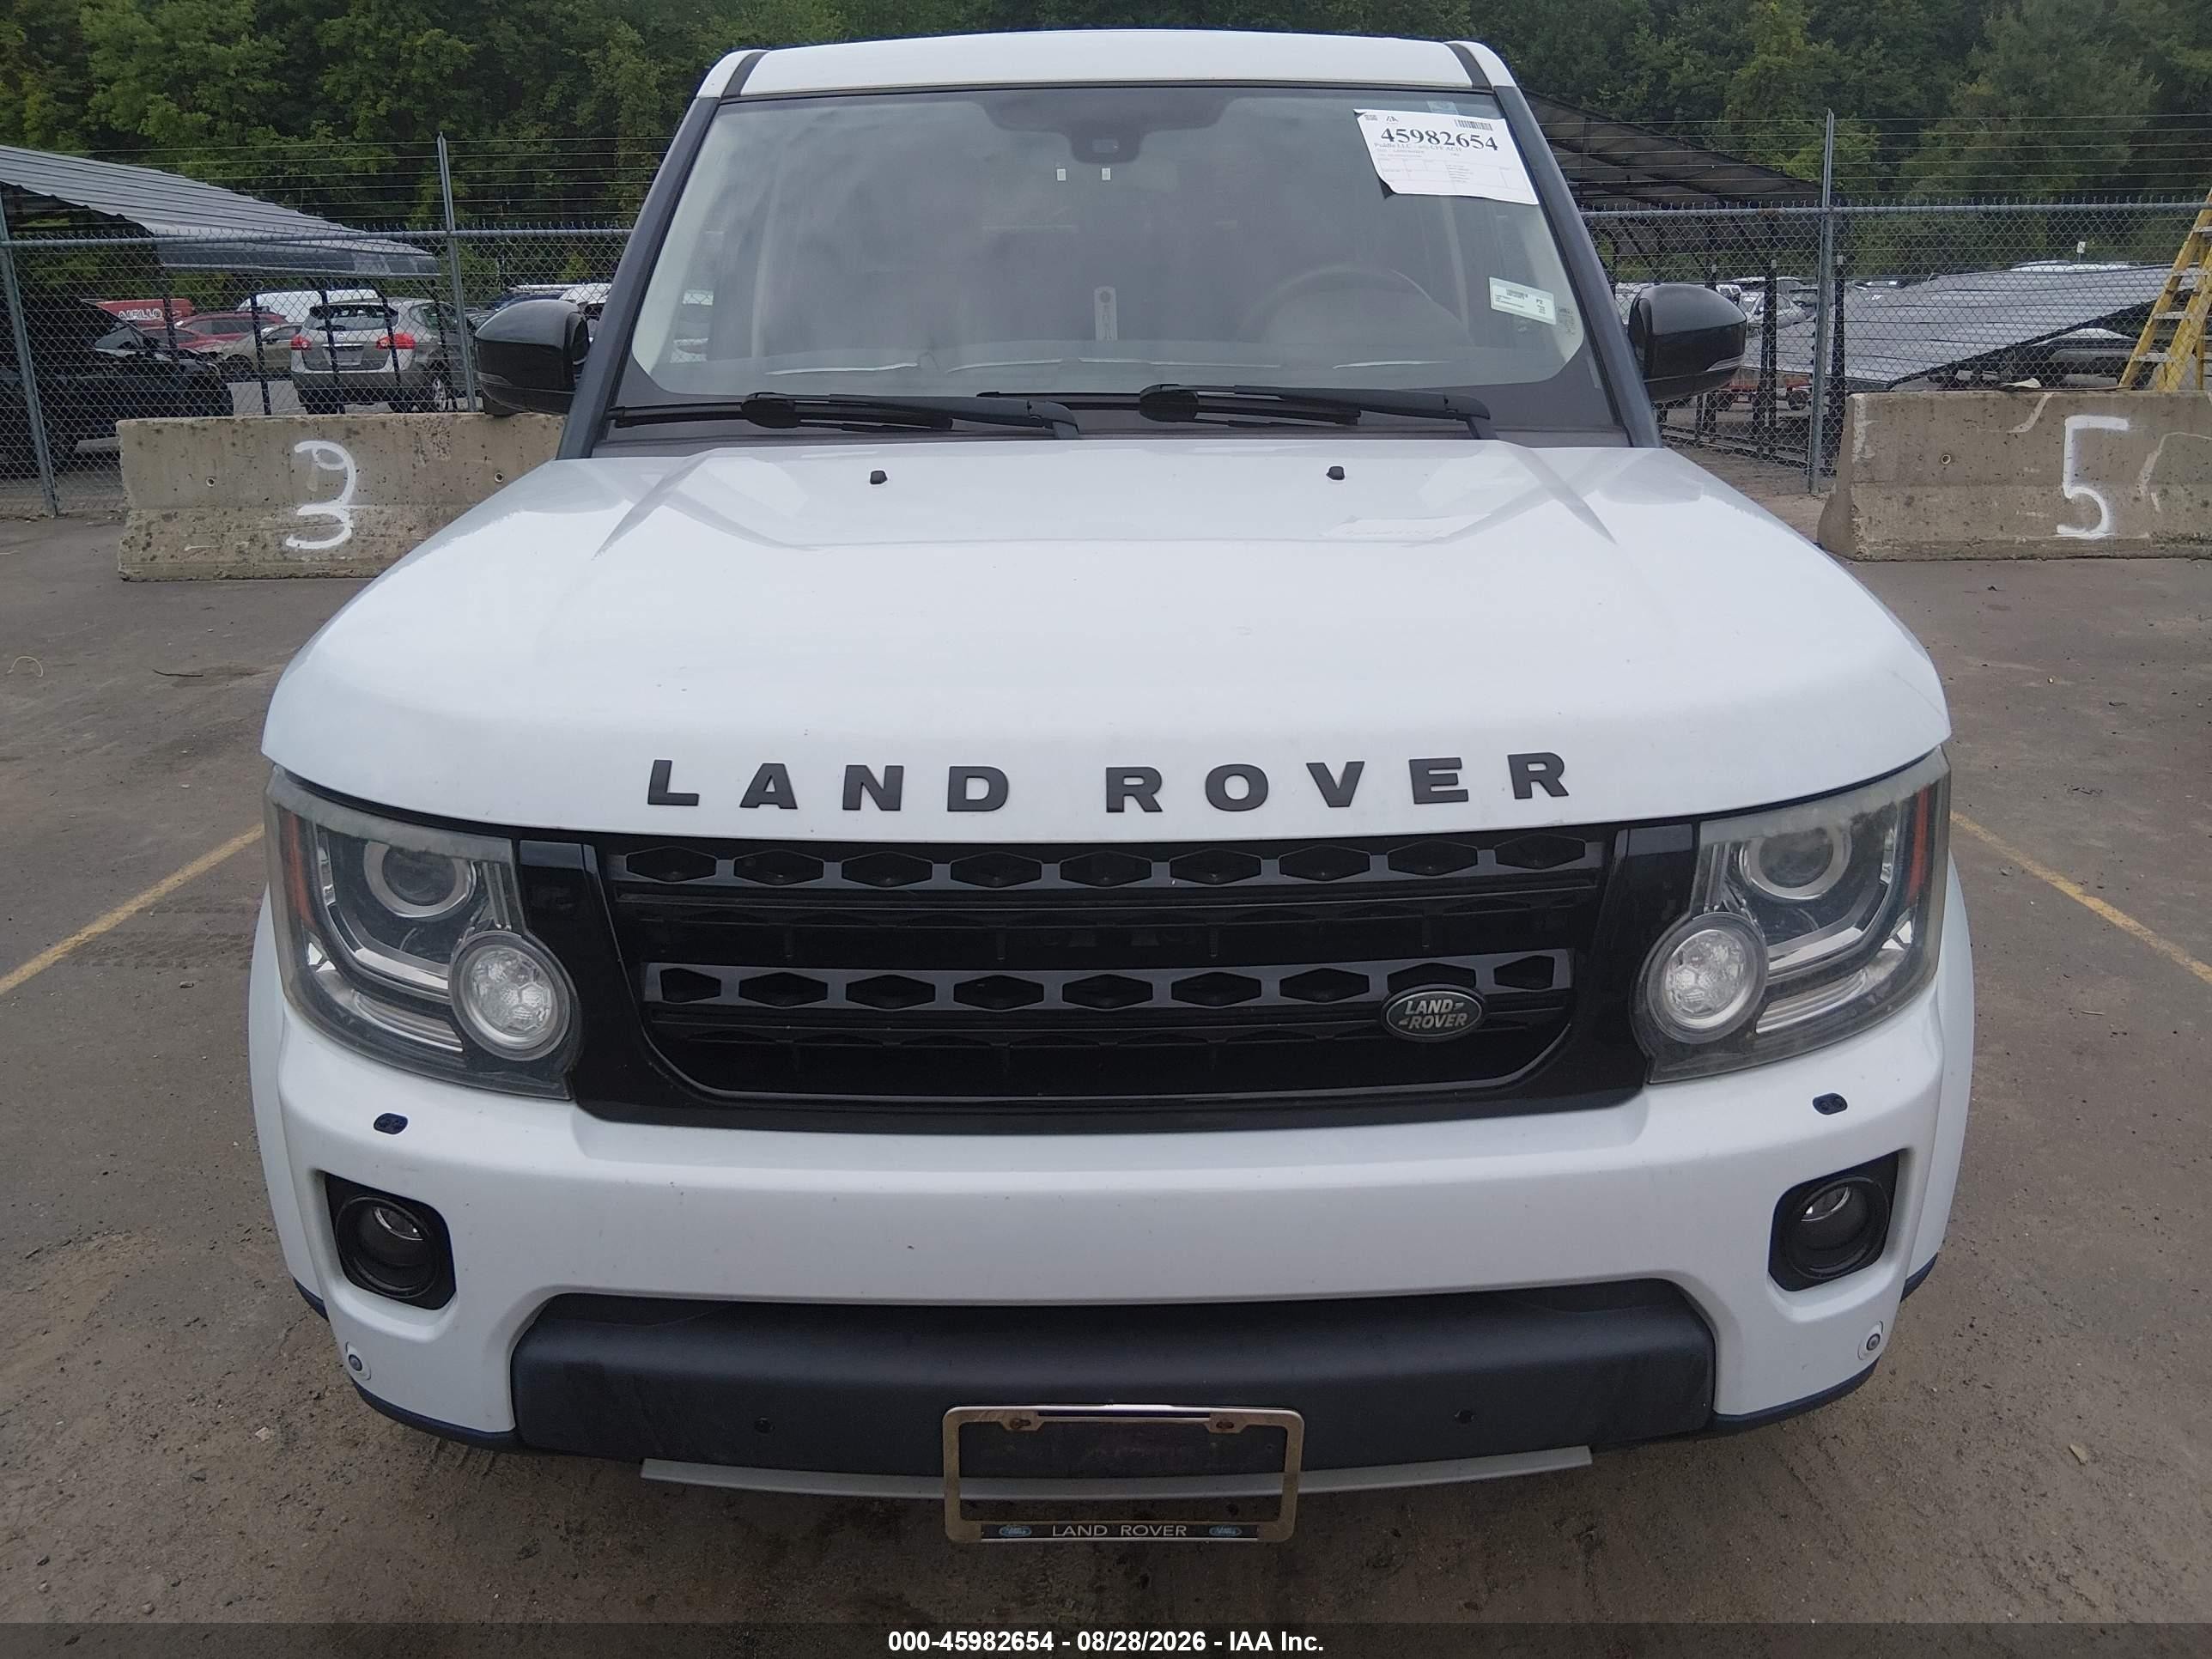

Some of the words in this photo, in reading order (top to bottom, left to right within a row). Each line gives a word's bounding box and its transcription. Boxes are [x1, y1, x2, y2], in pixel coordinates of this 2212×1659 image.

[1380, 128, 1498, 151] 45982654
[2057, 415, 2130, 540] 5
[286, 440, 356, 550] 3
[647, 759, 1009, 812] LAND
[1105, 751, 1570, 812] ROVER
[1404, 999, 1454, 1015] LAND
[1407, 1013, 1468, 1030] ROVER
[1052, 1524, 1108, 1537] LAND
[1120, 1524, 1188, 1537] ROVER
